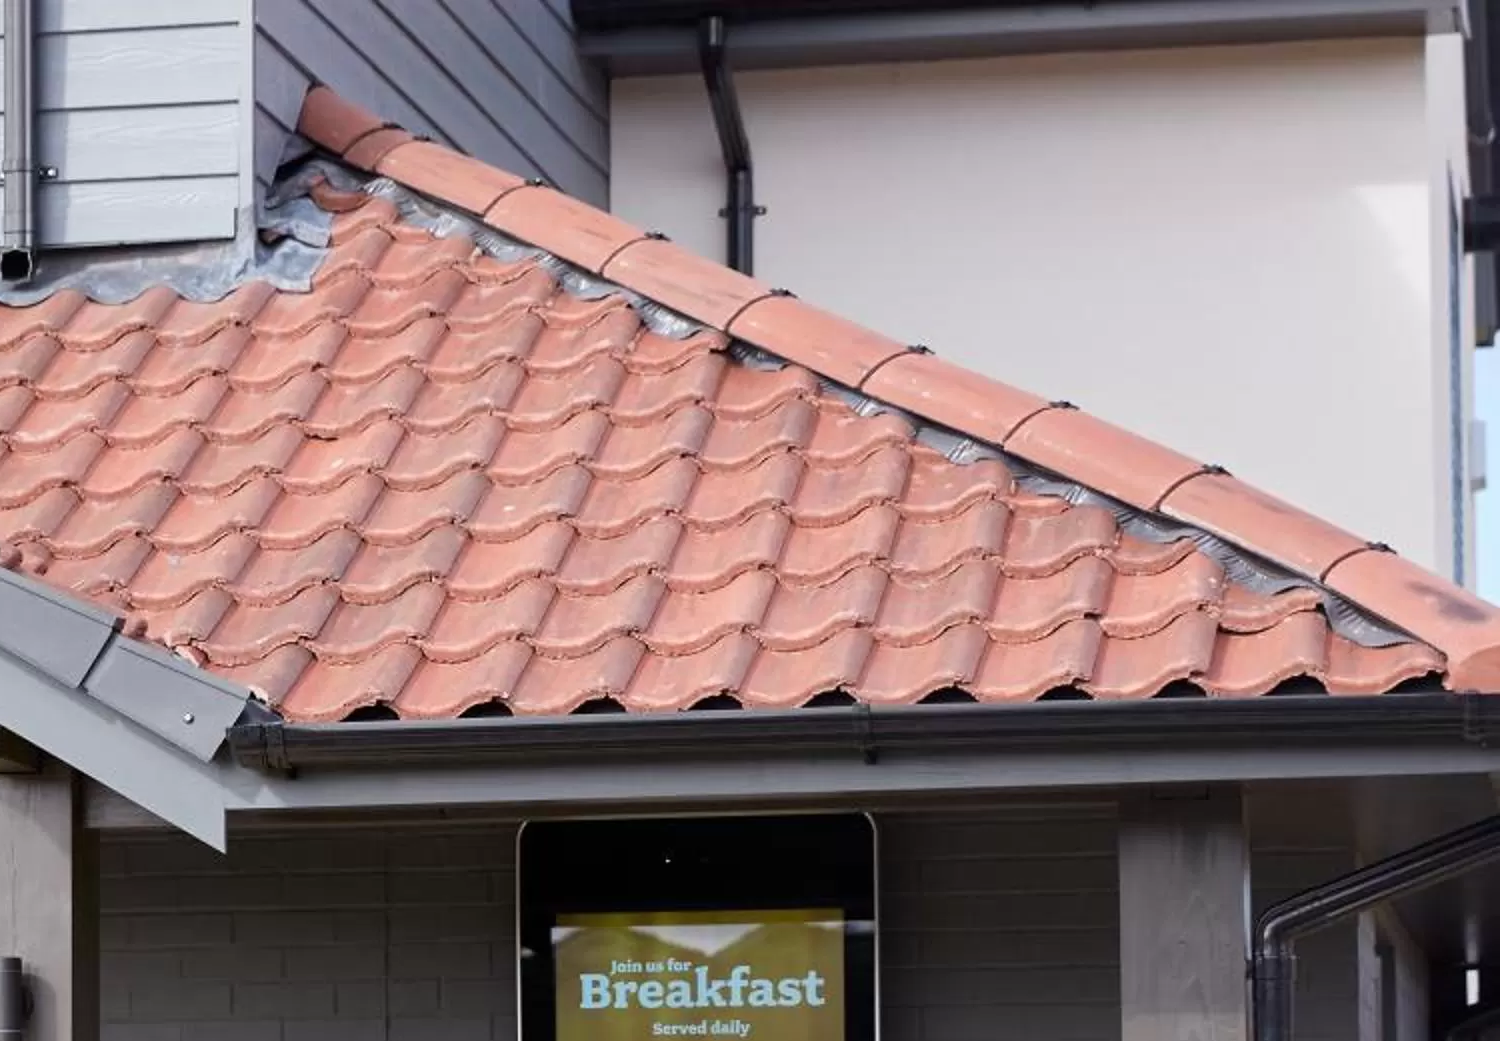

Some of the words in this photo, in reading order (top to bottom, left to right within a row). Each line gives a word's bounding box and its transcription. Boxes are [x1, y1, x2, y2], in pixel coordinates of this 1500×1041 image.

[610, 959, 642, 974] Join
[645, 961, 664, 973] us
[667, 958, 692, 972] for
[579, 965, 825, 1009] Breakfast
[652, 1020, 707, 1035] Served
[711, 1020, 750, 1037] daily
